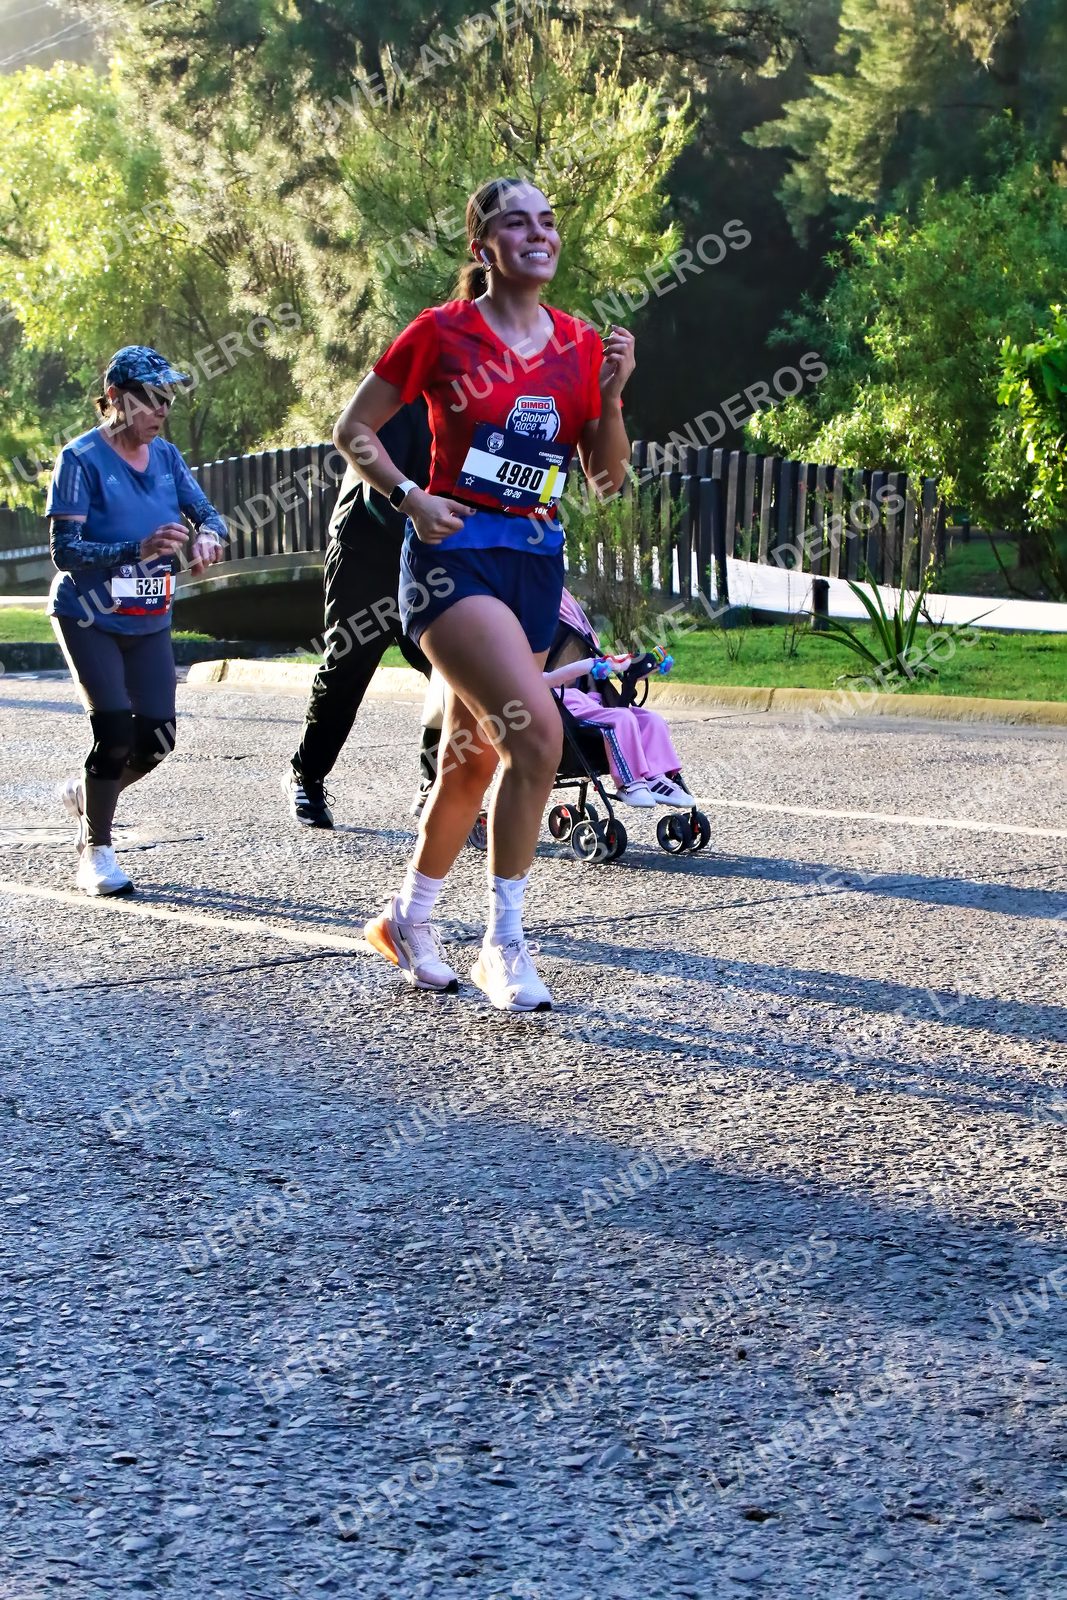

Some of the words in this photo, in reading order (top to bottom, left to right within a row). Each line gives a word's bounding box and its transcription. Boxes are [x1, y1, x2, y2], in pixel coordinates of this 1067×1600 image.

[520, 401, 550, 410] BIMBO
[520, 412, 549, 423] Global
[514, 422, 537, 431] Race
[496, 460, 544, 491] 4980
[503, 488, 522, 499] 20-26
[534, 507, 549, 515] 10K
[136, 579, 163, 595] 5237
